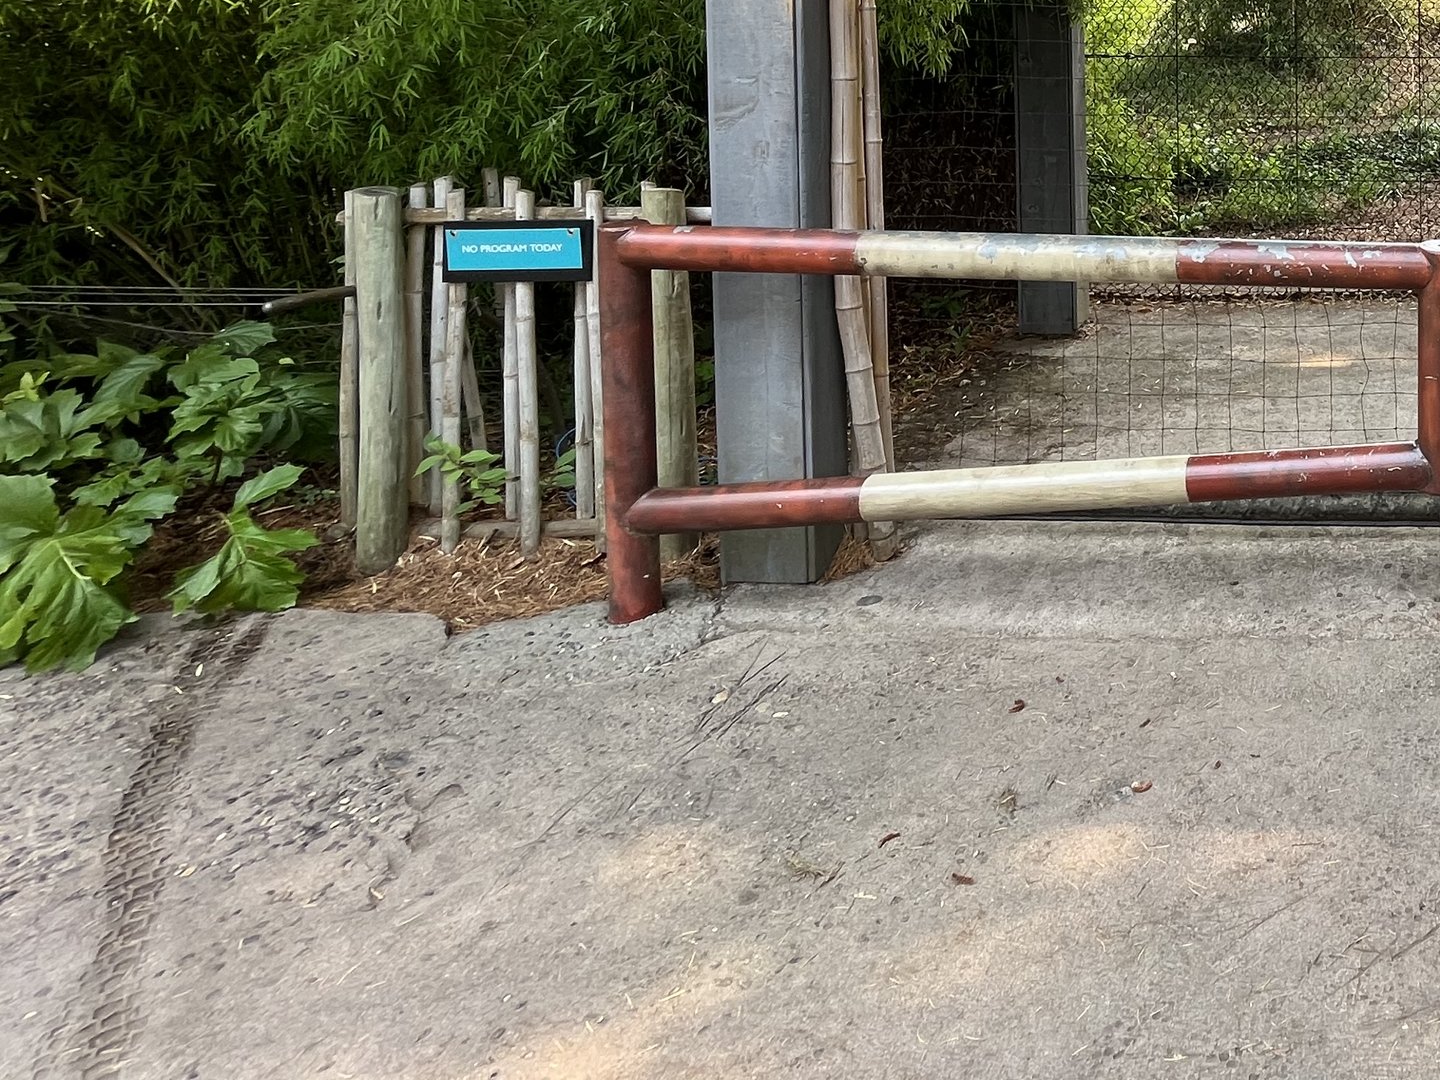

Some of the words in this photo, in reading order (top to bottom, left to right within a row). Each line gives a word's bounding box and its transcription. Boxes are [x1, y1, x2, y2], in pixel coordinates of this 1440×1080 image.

[461, 244, 477, 254] NO
[480, 243, 528, 253] PROGRAM
[529, 243, 563, 252] TODAY
